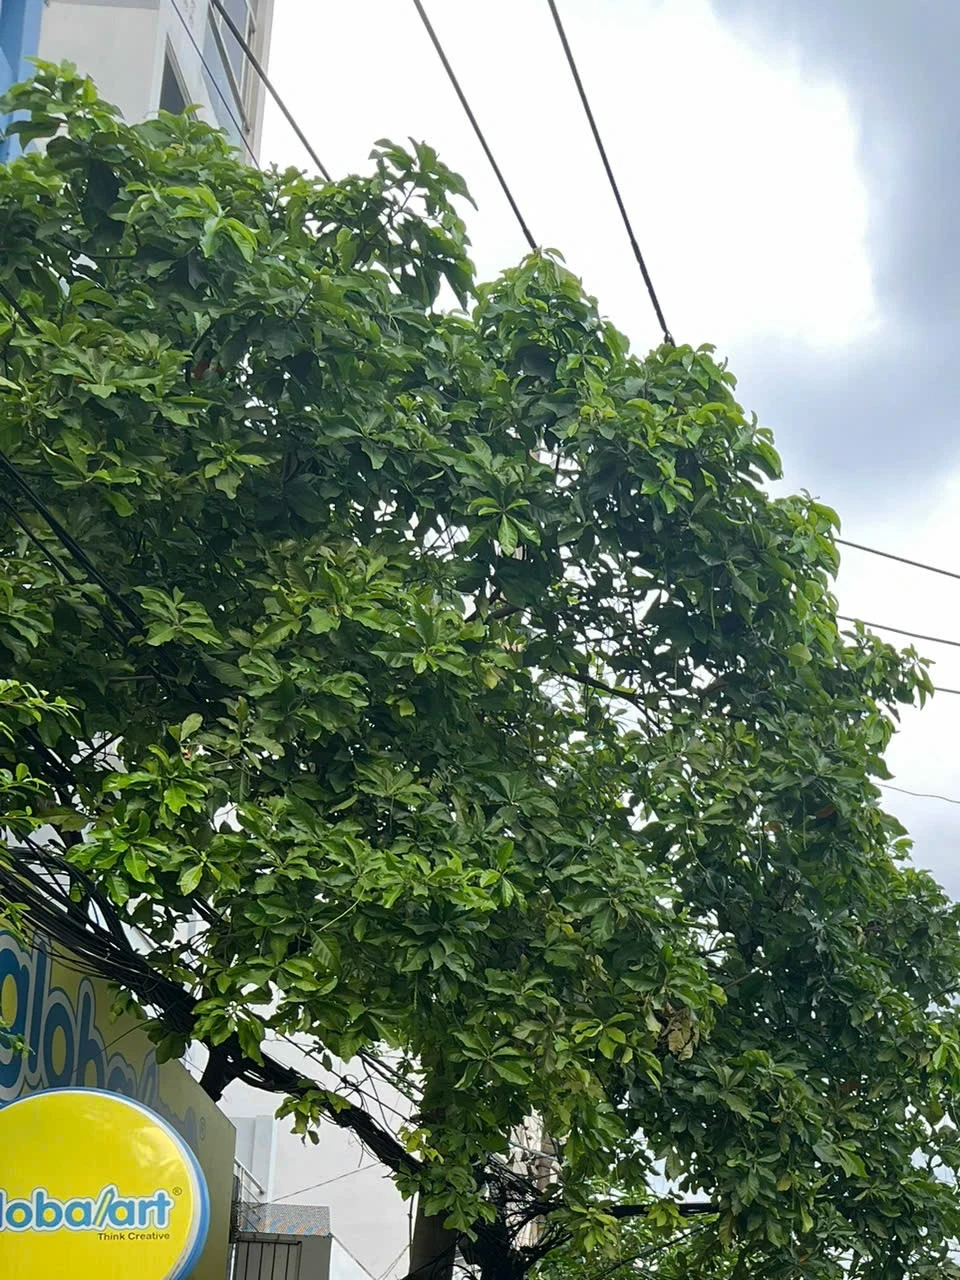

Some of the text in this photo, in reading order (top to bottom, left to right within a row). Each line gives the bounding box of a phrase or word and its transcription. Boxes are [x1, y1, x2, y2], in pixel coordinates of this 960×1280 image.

[0, 1186, 173, 1230] lobalart
[98, 1232, 170, 1241] Think Creative
